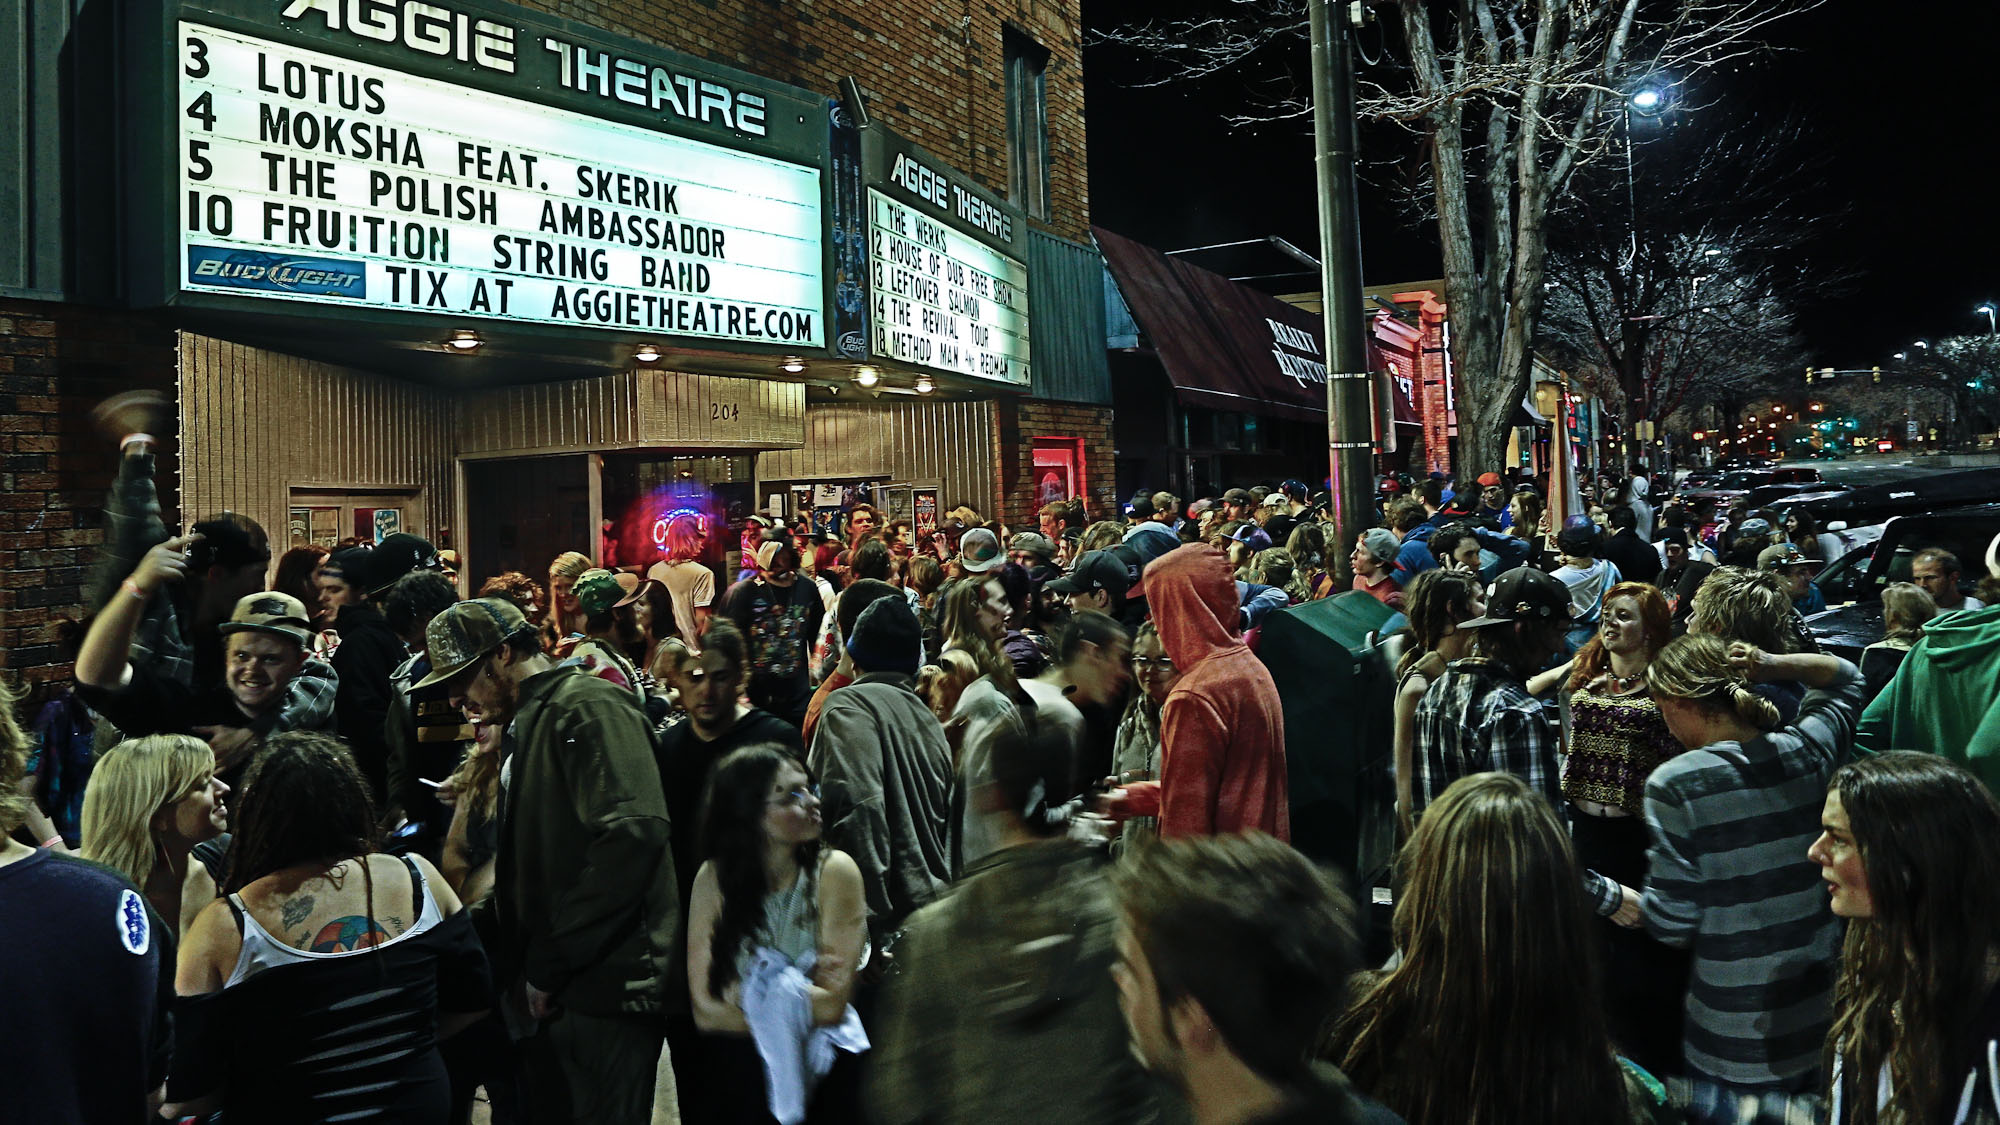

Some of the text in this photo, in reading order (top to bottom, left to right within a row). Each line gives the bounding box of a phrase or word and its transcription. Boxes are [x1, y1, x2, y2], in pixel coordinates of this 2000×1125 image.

[185, 37, 386, 115] 3 LOTUS
[281, 0, 765, 136] AGGIE THEATRE
[186, 91, 679, 215] 4 MOKSHA FEAT. SKERIK
[188, 139, 725, 259] 5 THE POLISH AMBASSADOR
[887, 204, 907, 236] THE
[914, 216, 947, 253] WERKS
[890, 152, 1012, 243] AGGIE THEATRE
[188, 190, 711, 294] 10 FRUITION STRING BAND
[194, 259, 265, 280] BUD
[872, 228, 1013, 307] 12 HOUSE OF DUB FREE SHOW
[385, 266, 812, 342] TIX AT AGGIETHEATRE.COM
[872, 260, 980, 320] 13 LEFTOVER SALMON
[873, 292, 989, 349] 14 THE REVIVAL TOUR
[842, 342, 866, 353] LIGHT
[846, 335, 865, 345] BUD
[876, 326, 886, 353] 18
[892, 331, 931, 362] METHOD
[940, 342, 959, 368] MAN
[980, 352, 1009, 379] REDMAN
[711, 402, 739, 422] 204
